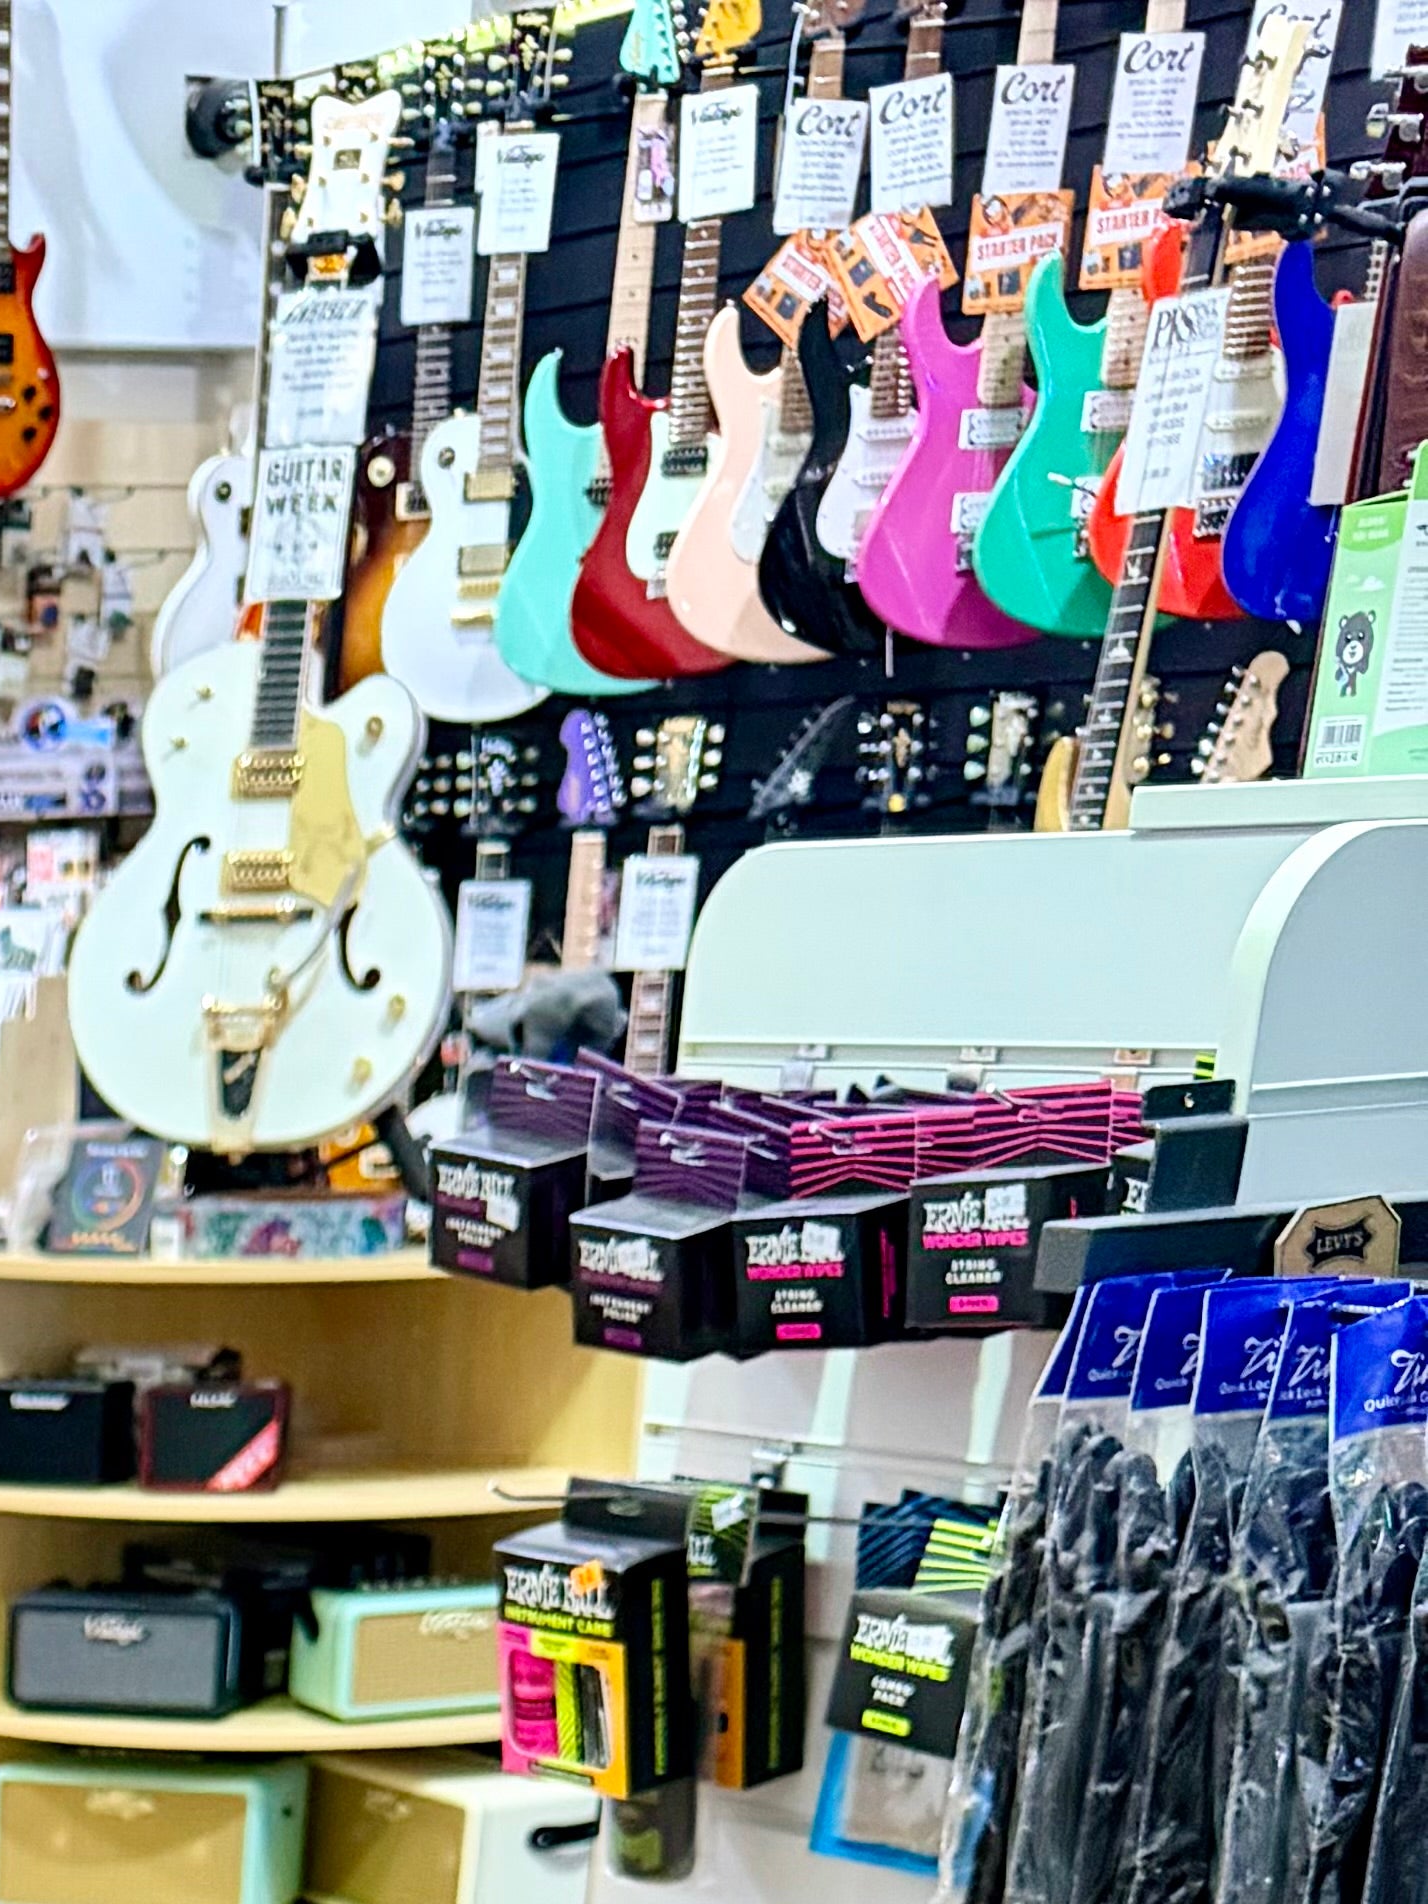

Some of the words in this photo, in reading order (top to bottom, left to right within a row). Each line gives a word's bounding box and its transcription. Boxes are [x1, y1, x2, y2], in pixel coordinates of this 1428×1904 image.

[1124, 40, 1194, 74] Cort
[879, 84, 946, 125] Cort
[1001, 72, 1065, 105] Cort
[796, 105, 860, 137] Cort
[978, 236, 1025, 261] STARTER
[267, 457, 343, 485] GUITAR
[265, 492, 337, 517] WEEK
[923, 1191, 982, 1232] ERNIE
[745, 1224, 801, 1264] ERNIE
[922, 1232, 979, 1250] WONDER
[983, 1230, 1029, 1248] WIPES
[1316, 1232, 1364, 1255] LEVY'S
[504, 1563, 561, 1609] ERNIE
